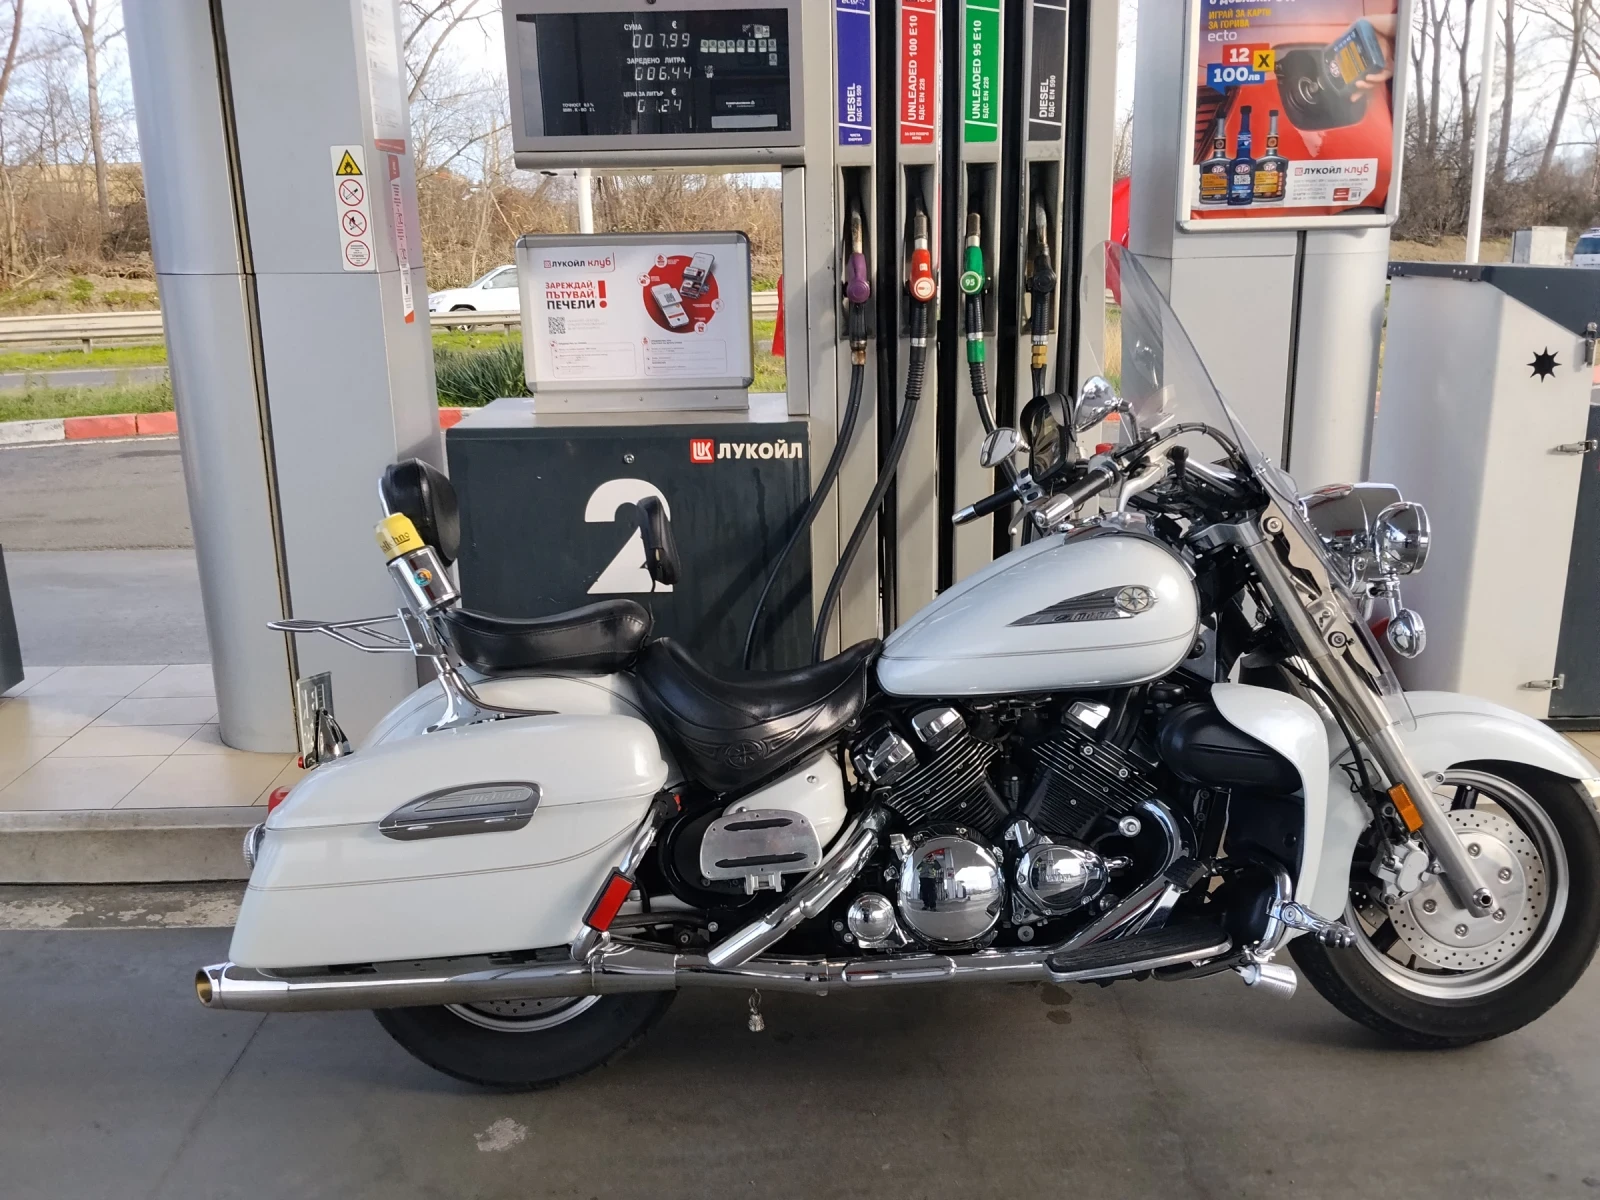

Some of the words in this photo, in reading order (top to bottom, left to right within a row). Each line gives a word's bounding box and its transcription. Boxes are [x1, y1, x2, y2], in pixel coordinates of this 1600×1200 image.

[1208, 9, 1233, 19] ИГРАЙ
[1236, 9, 1245, 18] ЗА
[623, 23, 643, 31] СУМА
[909, 15, 918, 36] E10
[1208, 21, 1218, 29] ЗА
[1220, 19, 1250, 28] ГОРИВА
[973, 20, 982, 40] E10
[1207, 30, 1238, 41] ecto
[909, 37, 918, 58] 100
[973, 43, 982, 56] 95
[626, 57, 660, 65] ЗАРЕДЕНО
[664, 56, 686, 64] ЛИТРА
[1229, 48, 1250, 62] 12
[908, 59, 917, 121] UNLEADED
[972, 58, 981, 119] UNLEADED
[919, 92, 925, 103] EN
[983, 91, 989, 101] EN
[1039, 79, 1048, 118] DIESEL
[1049, 89, 1056, 100] EN
[847, 82, 856, 122] DIESEL
[856, 96, 862, 107] EN
[1303, 166, 1341, 175] ЛУКОЙЛ
[1344, 164, 1369, 175] клуб
[552, 259, 585, 267] ЛУКОЙЛ
[587, 257, 611, 268] клуб
[965, 279, 975, 287] 95
[717, 439, 803, 459] ЛУКОЙЛ
[585, 478, 674, 594] 2
